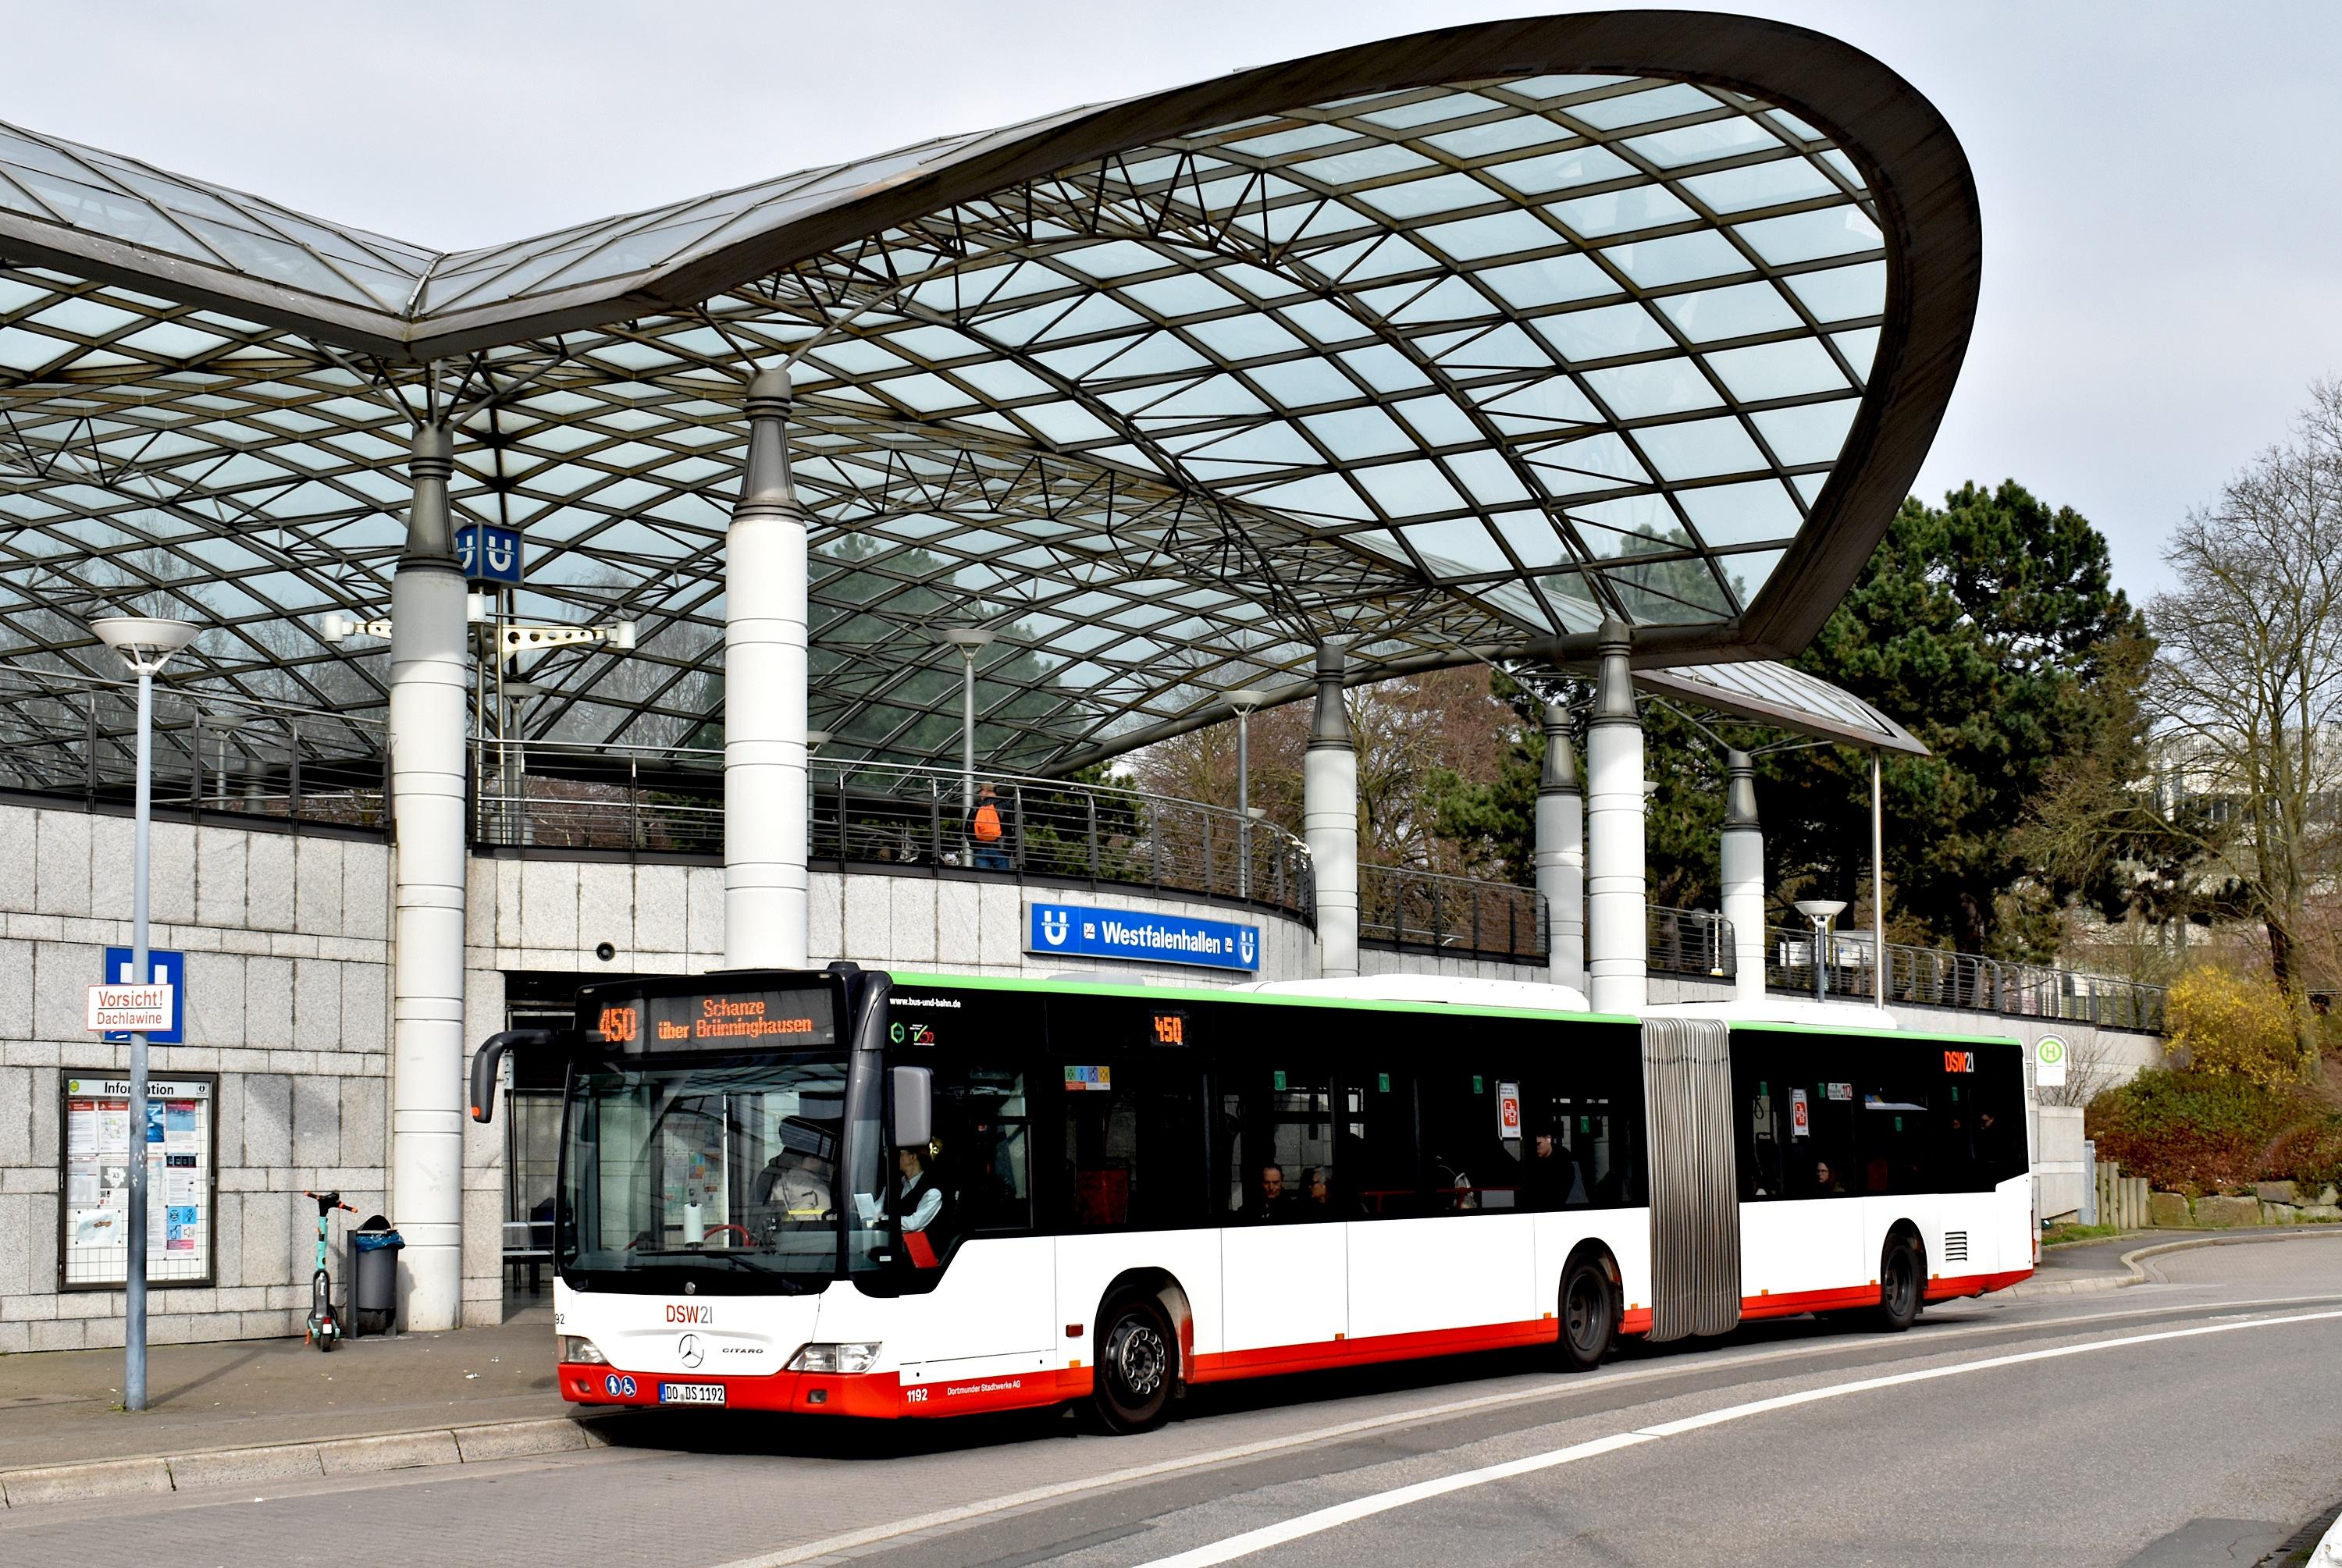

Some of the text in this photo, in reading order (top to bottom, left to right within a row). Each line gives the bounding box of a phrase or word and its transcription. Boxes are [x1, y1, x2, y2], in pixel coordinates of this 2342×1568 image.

[1102, 921, 1220, 954] Westfalenhallen
[98, 990, 163, 1007] Vorsicht!
[889, 997, 961, 1008] www.bus-und-bahn.de
[703, 999, 765, 1017] Schanze
[97, 1012, 162, 1025] Dachlawine
[599, 1008, 636, 1042] 450
[658, 1018, 813, 1040] über Brünninghausen
[1154, 1016, 1182, 1043] 450
[2045, 1046, 2055, 1058] H
[1944, 1051, 1975, 1073] DSW21
[104, 1082, 174, 1095] Infortion
[666, 1305, 713, 1324] DSW21
[666, 1385, 724, 1402] DO DS 1192
[906, 1388, 928, 1403] 1192
[947, 1380, 1021, 1396] Dortmunder Stadtwerke AG
